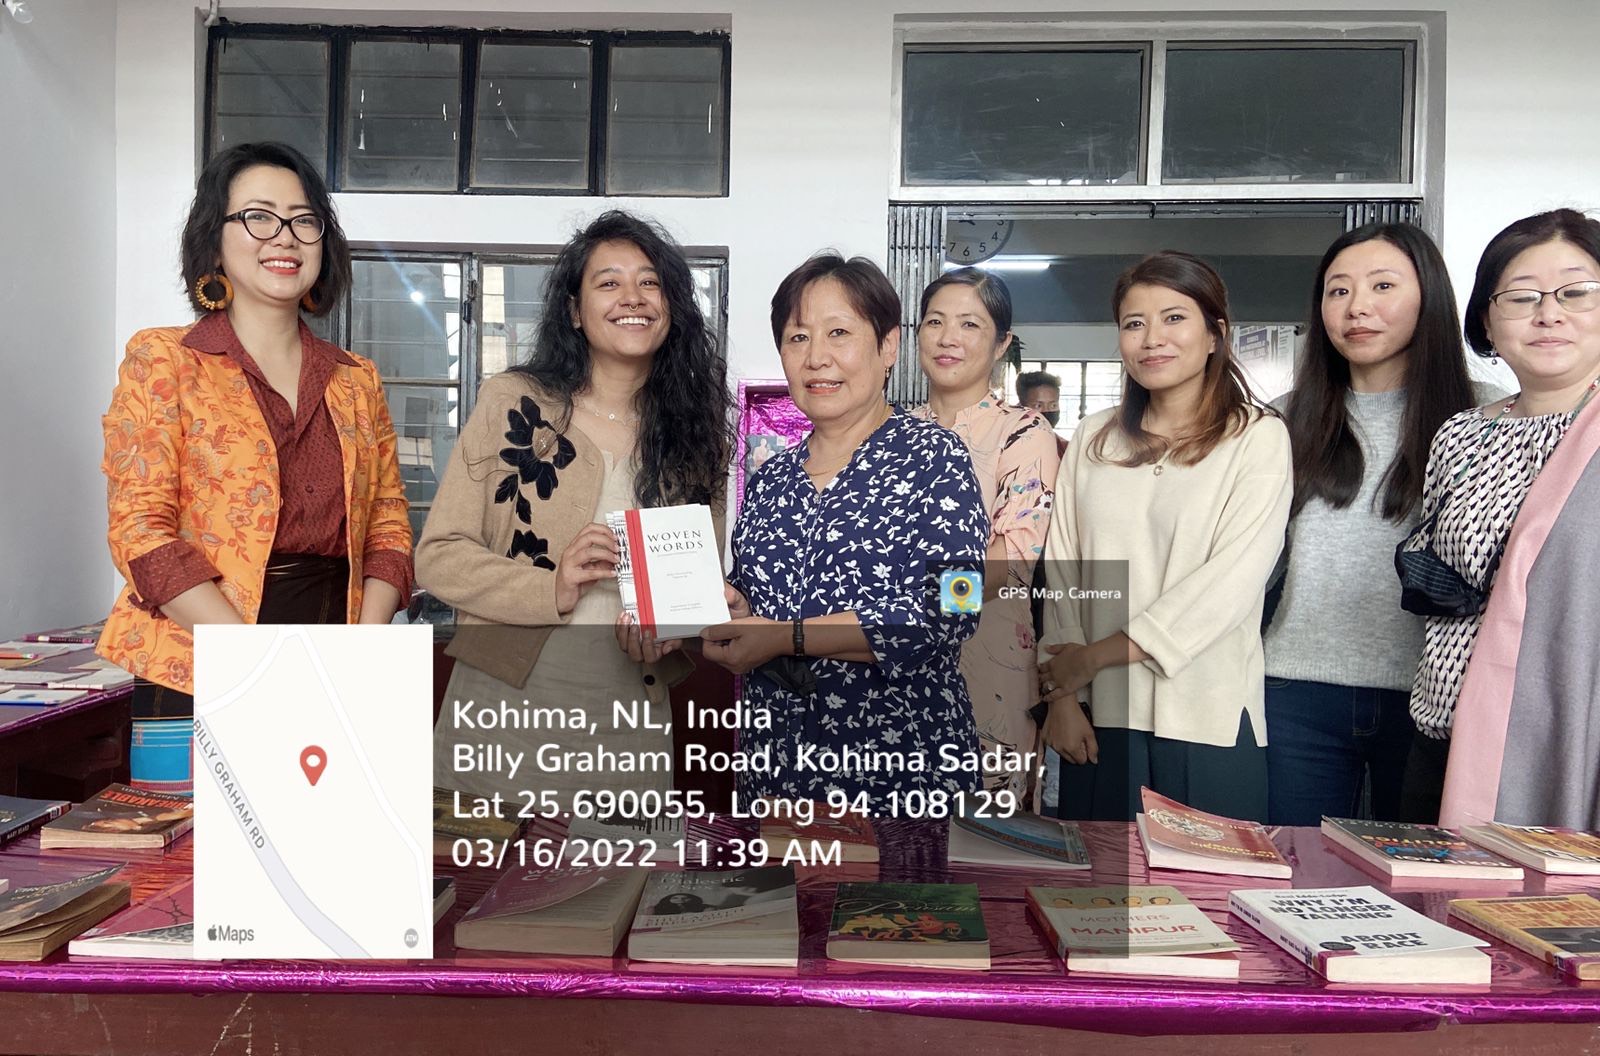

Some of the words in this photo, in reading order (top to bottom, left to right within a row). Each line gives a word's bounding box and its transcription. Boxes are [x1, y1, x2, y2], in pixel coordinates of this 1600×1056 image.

[991, 231, 999, 241] 4
[949, 242, 956, 253] 7
[962, 246, 970, 257] 6
[979, 242, 986, 253] 5
[647, 529, 703, 542] WOVEN
[649, 540, 704, 553] WORDS
[660, 876, 746, 886] Dialectic
[1270, 899, 1328, 908] WHY
[1333, 897, 1371, 906] I'M
[1269, 905, 1304, 915] NO
[1307, 903, 1398, 914] LONGER
[1080, 913, 1172, 923] MOTHERS
[1292, 911, 1394, 921] TALKING
[1070, 924, 1199, 936] MANIPUR
[1340, 931, 1423, 943] ABOUT
[1361, 939, 1429, 950] RACE
